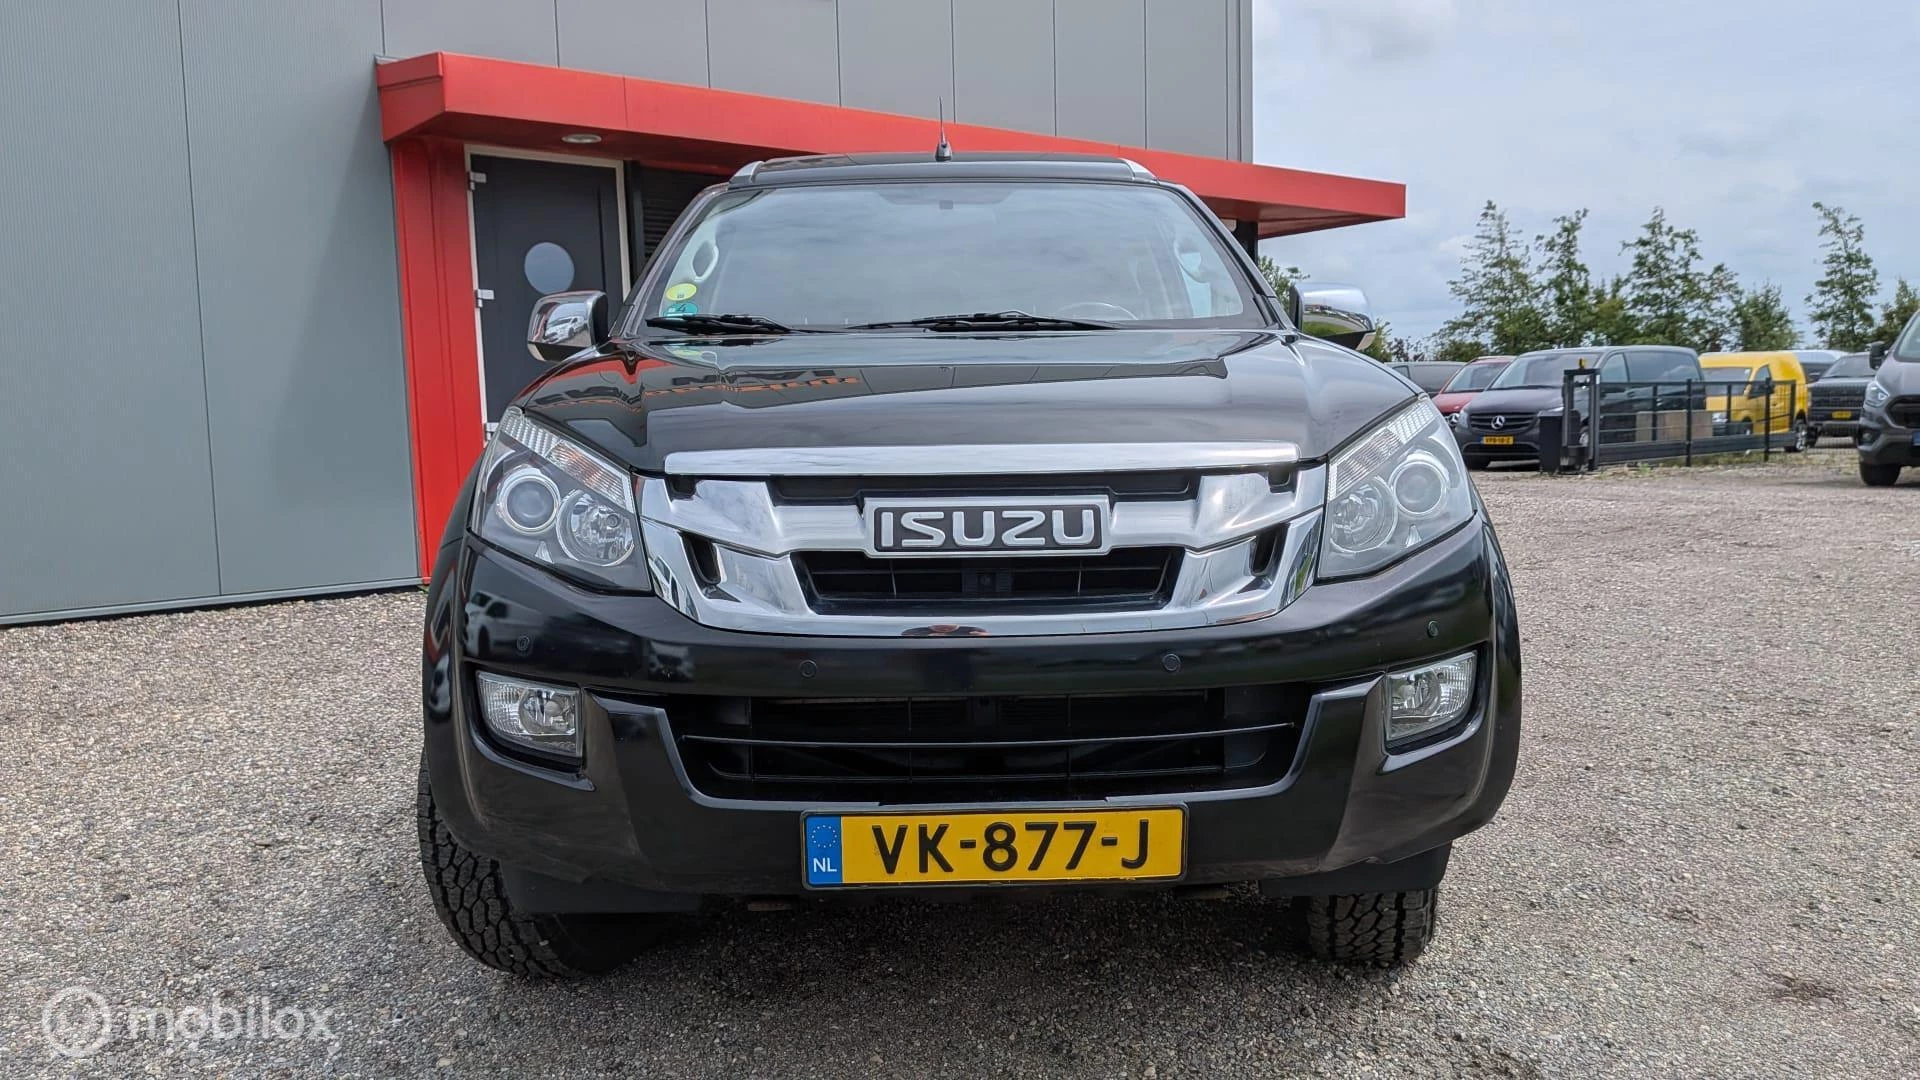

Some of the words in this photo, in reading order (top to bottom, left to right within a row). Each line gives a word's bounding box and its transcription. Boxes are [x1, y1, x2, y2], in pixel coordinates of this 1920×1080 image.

[880, 509, 1095, 548] ISUZU
[812, 856, 837, 873] NL
[872, 819, 1150, 875] VK-877-J
